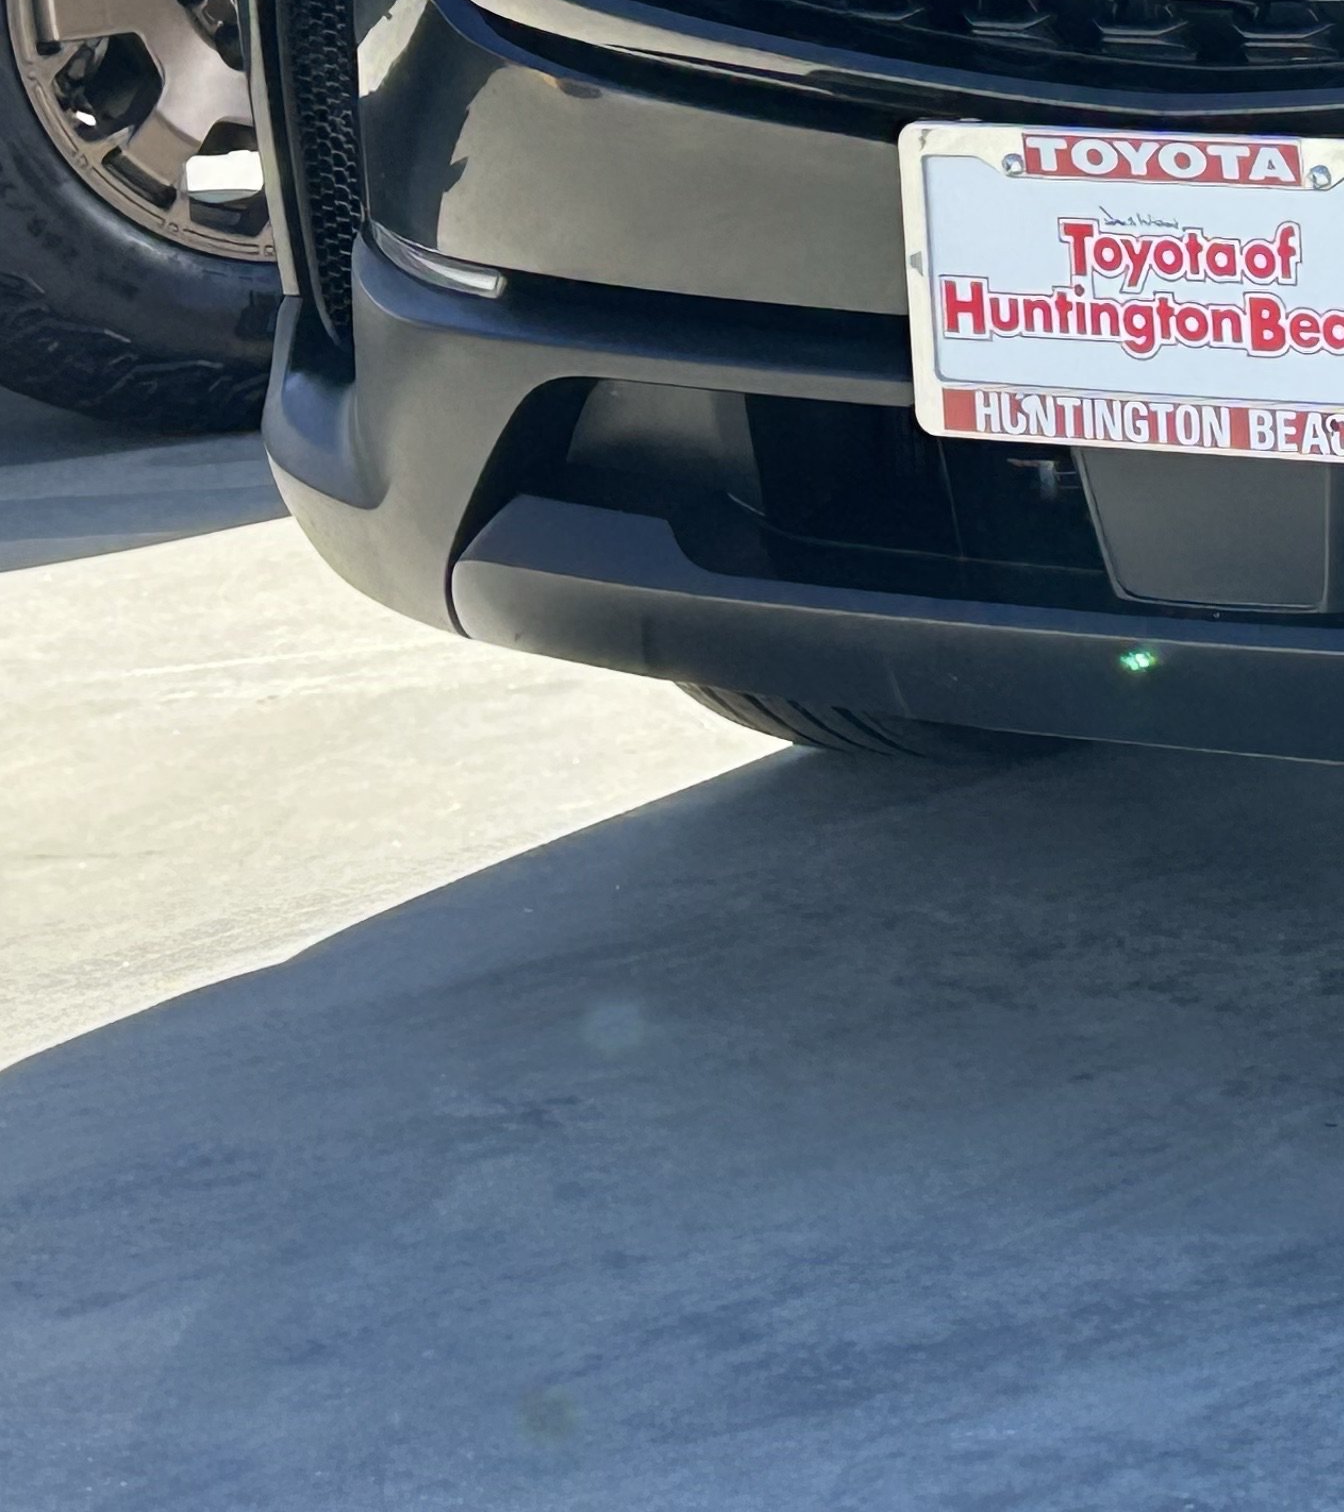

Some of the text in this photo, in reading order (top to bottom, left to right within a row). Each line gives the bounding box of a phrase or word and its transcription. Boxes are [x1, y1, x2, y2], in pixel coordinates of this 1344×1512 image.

[1025, 136, 1296, 184] TOYOTA
[1061, 221, 1239, 288] Toyota
[943, 279, 1244, 354] Huntington
[974, 390, 1232, 449] HUNTINGTON
